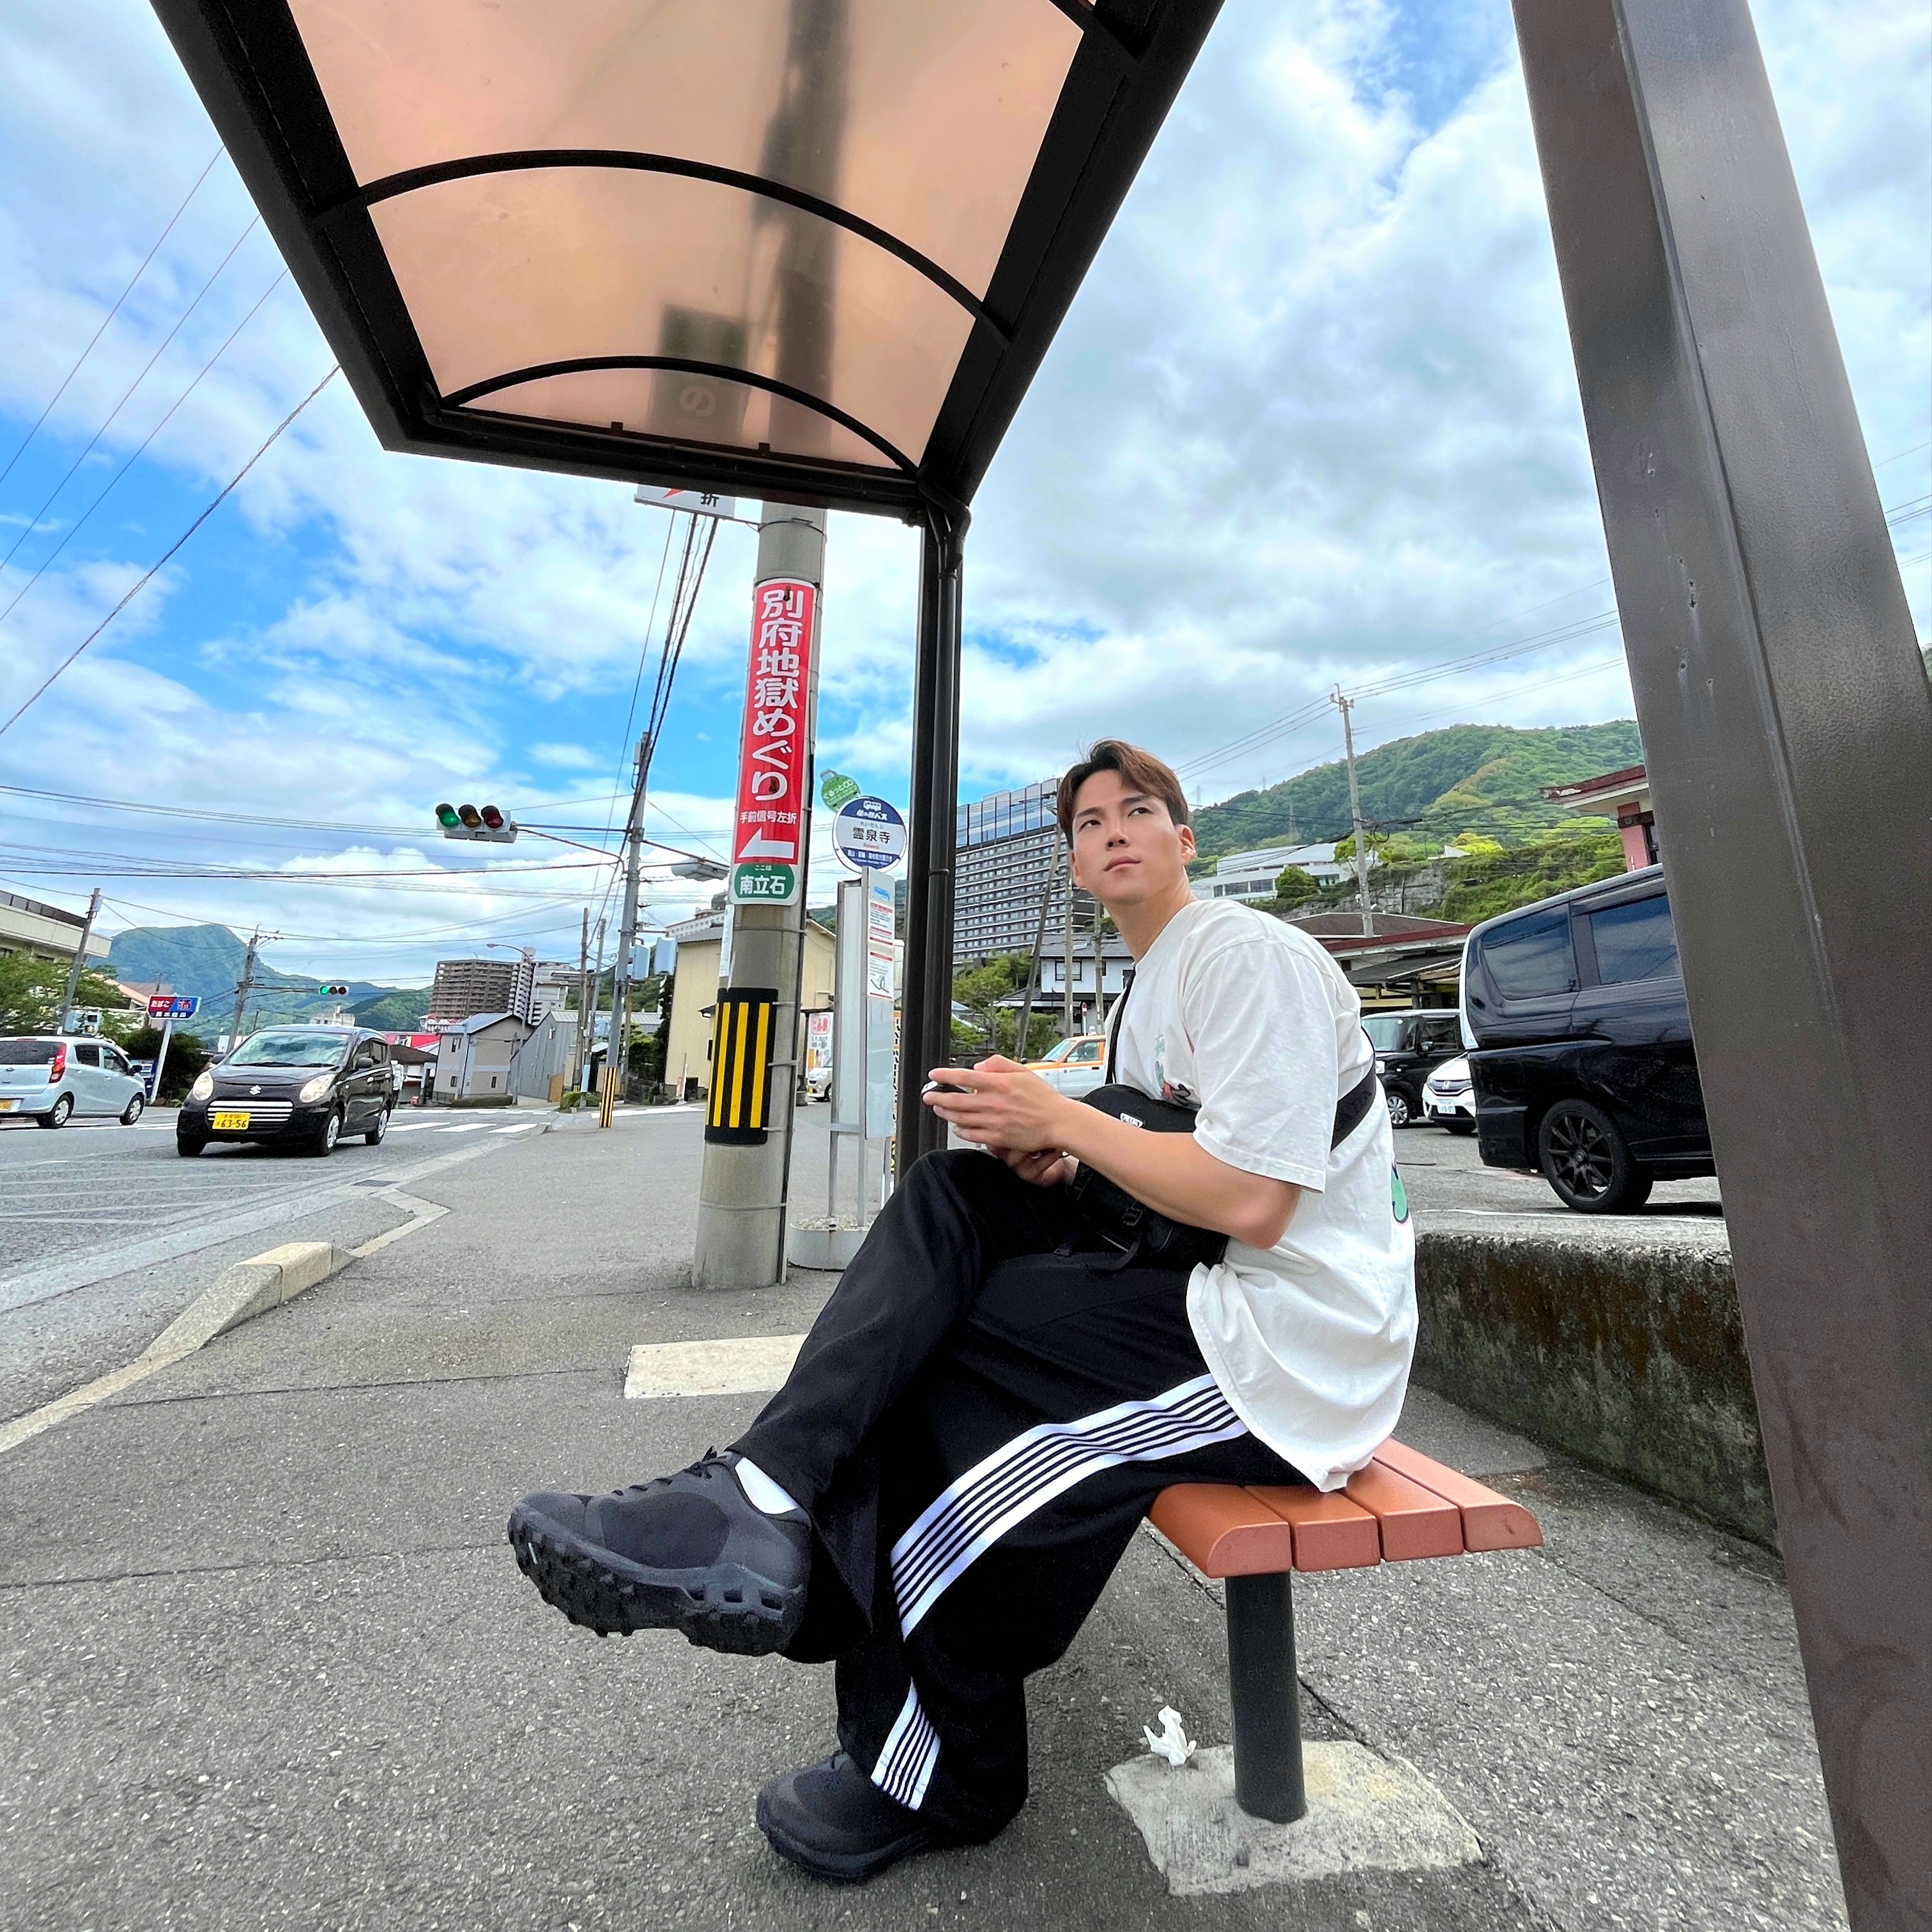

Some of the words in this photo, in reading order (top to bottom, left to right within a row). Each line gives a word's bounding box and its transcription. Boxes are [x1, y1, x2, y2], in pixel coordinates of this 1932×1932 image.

[751, 589, 804, 801] 別府地獄めぐり
[740, 810, 797, 825] 手前信号左折
[853, 826, 891, 843] 霊泉寺
[740, 875, 786, 895] 南立石
[220, 1119, 247, 1128] 63-56
